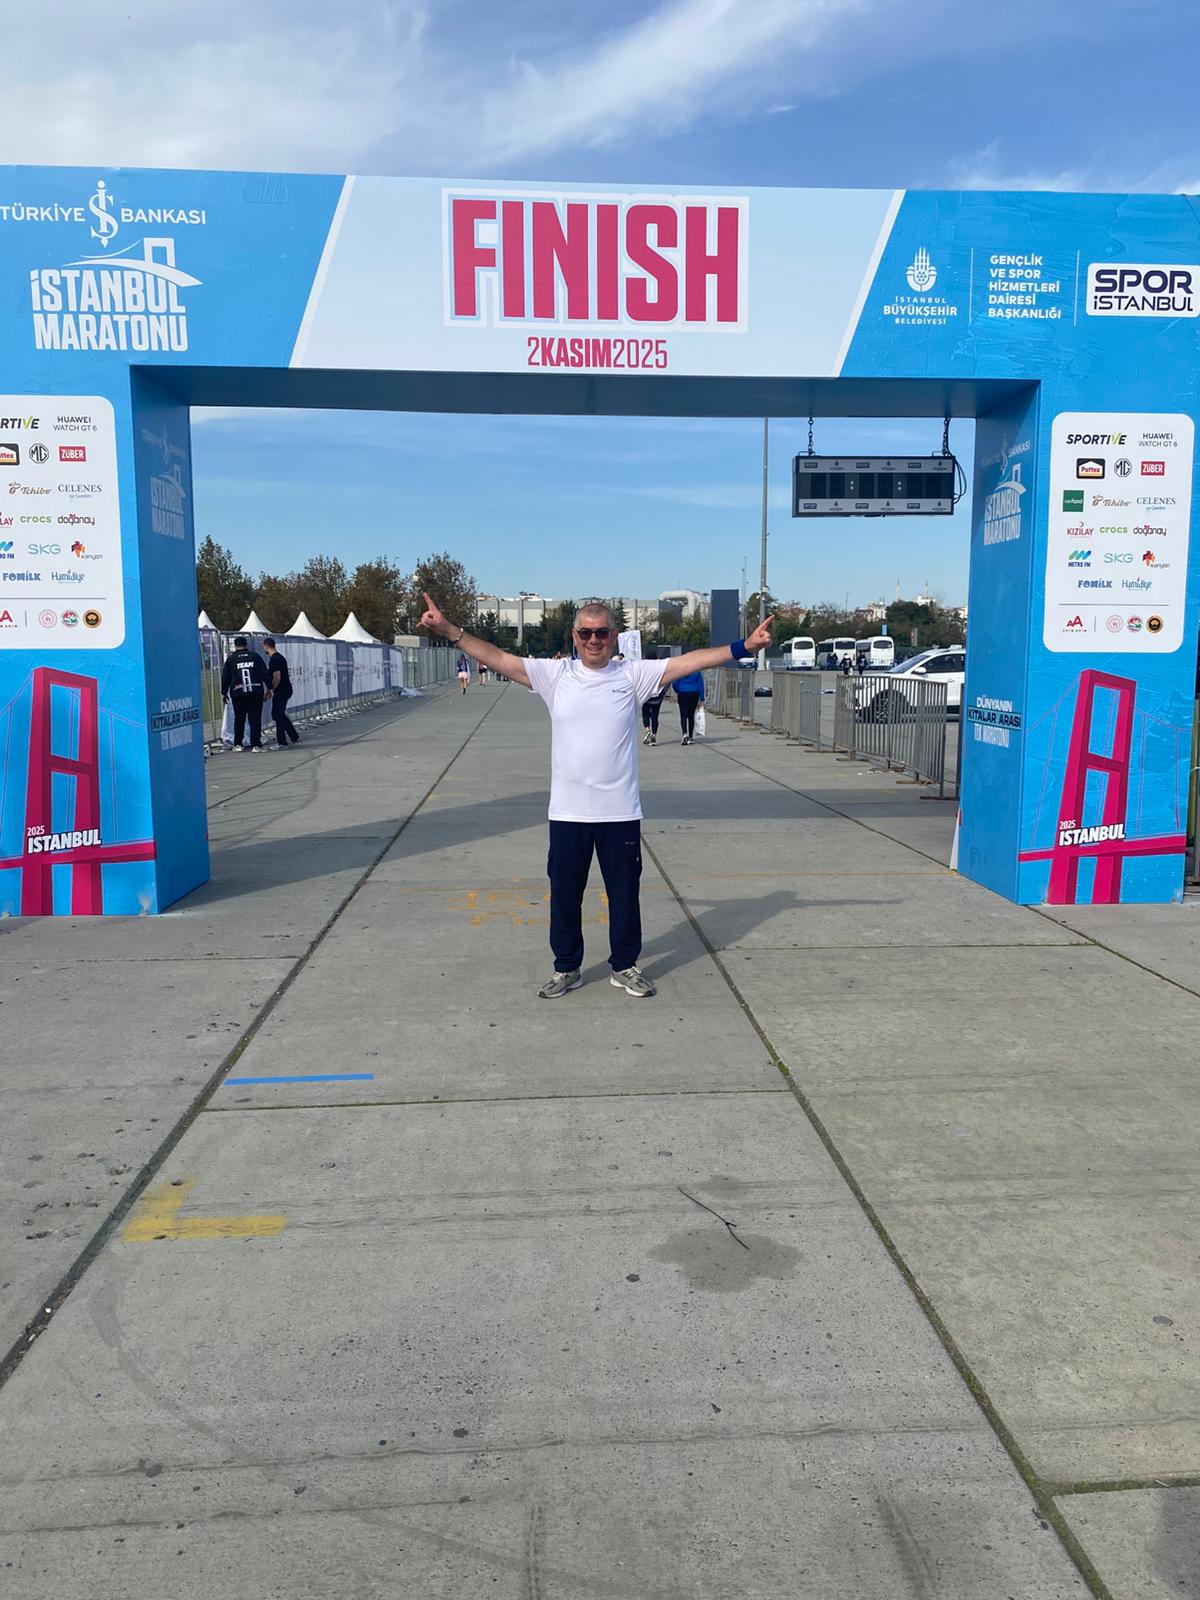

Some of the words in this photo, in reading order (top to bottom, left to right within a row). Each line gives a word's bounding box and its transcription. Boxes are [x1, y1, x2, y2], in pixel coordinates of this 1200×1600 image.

[0, 202, 86, 222] TÜRKİYE
[121, 208, 206, 225] BANKASI
[452, 198, 739, 322] FINISH
[990, 253, 1044, 267] GENÇLİK
[989, 268, 1006, 278] VE
[1008, 268, 1041, 279] SPOR
[989, 279, 1060, 292] HİZMETLERİ
[1095, 269, 1194, 294] SPOR
[895, 295, 947, 304] İSTANBUL
[988, 292, 1036, 305] DAİRESİ
[883, 303, 958, 317] BÜYÜKŞEHİR
[988, 306, 1061, 320] BAŞKANLIĞI
[895, 317, 946, 325] BELEDİYESİ
[32, 313, 188, 352] MARATONU
[0, 416, 40, 429] RTIVE
[57, 416, 92, 424] HUAWEI
[1066, 432, 1127, 445] SPORTIVE
[30, 444, 48, 463] MG
[1115, 460, 1131, 476] MG
[57, 483, 102, 493] CELENES
[1136, 496, 1176, 505] CELENES
[0, 518, 13, 526] LAY
[20, 515, 52, 523] crocs
[28, 544, 61, 555] SKG
[1103, 553, 1133, 563] SKG
[236, 661, 254, 669] TEAM
[976, 694, 1012, 712] DÜNYANIN
[968, 708, 996, 724] KITALAR
[998, 713, 1022, 728] ARASI
[27, 825, 45, 836] 2025
[1059, 819, 1076, 830] 2025
[28, 828, 101, 854] ISTANBUL
[1059, 823, 1126, 847] ISTANBUL
